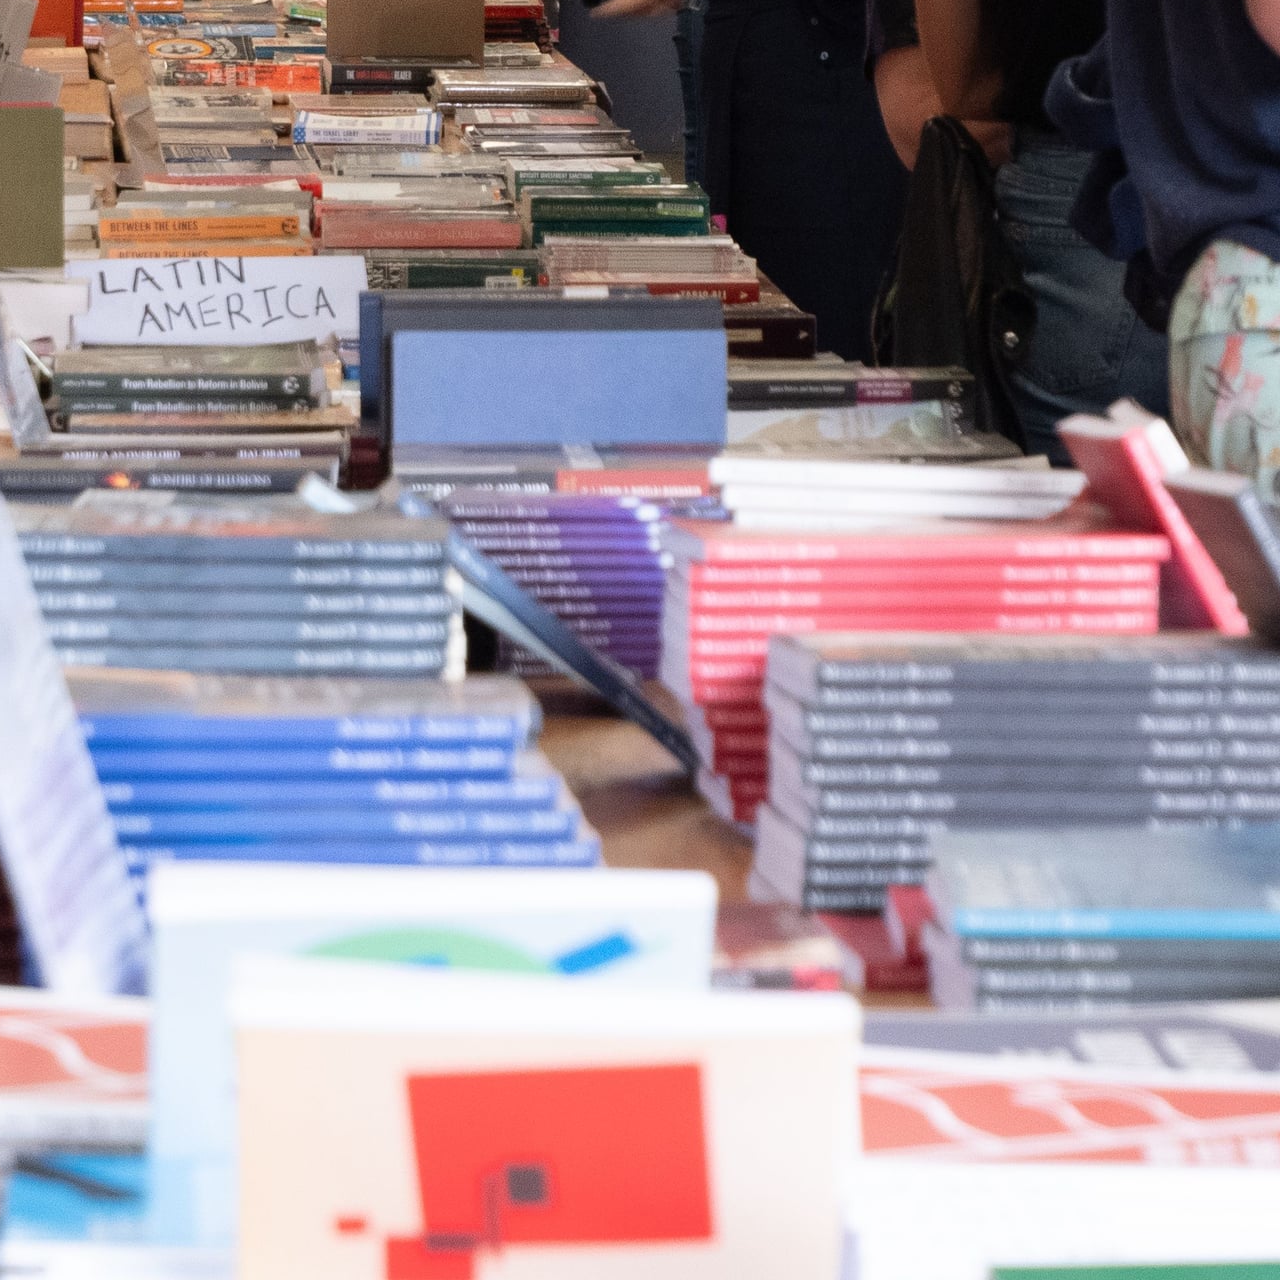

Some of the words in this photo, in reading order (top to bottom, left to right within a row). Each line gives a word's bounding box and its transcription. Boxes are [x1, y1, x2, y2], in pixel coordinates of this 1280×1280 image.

[110, 222, 151, 233] BETWEEN
[154, 221, 170, 232] THE
[173, 220, 199, 231] LINES
[99, 256, 246, 295] LATIN
[138, 284, 336, 336] AMERICA
